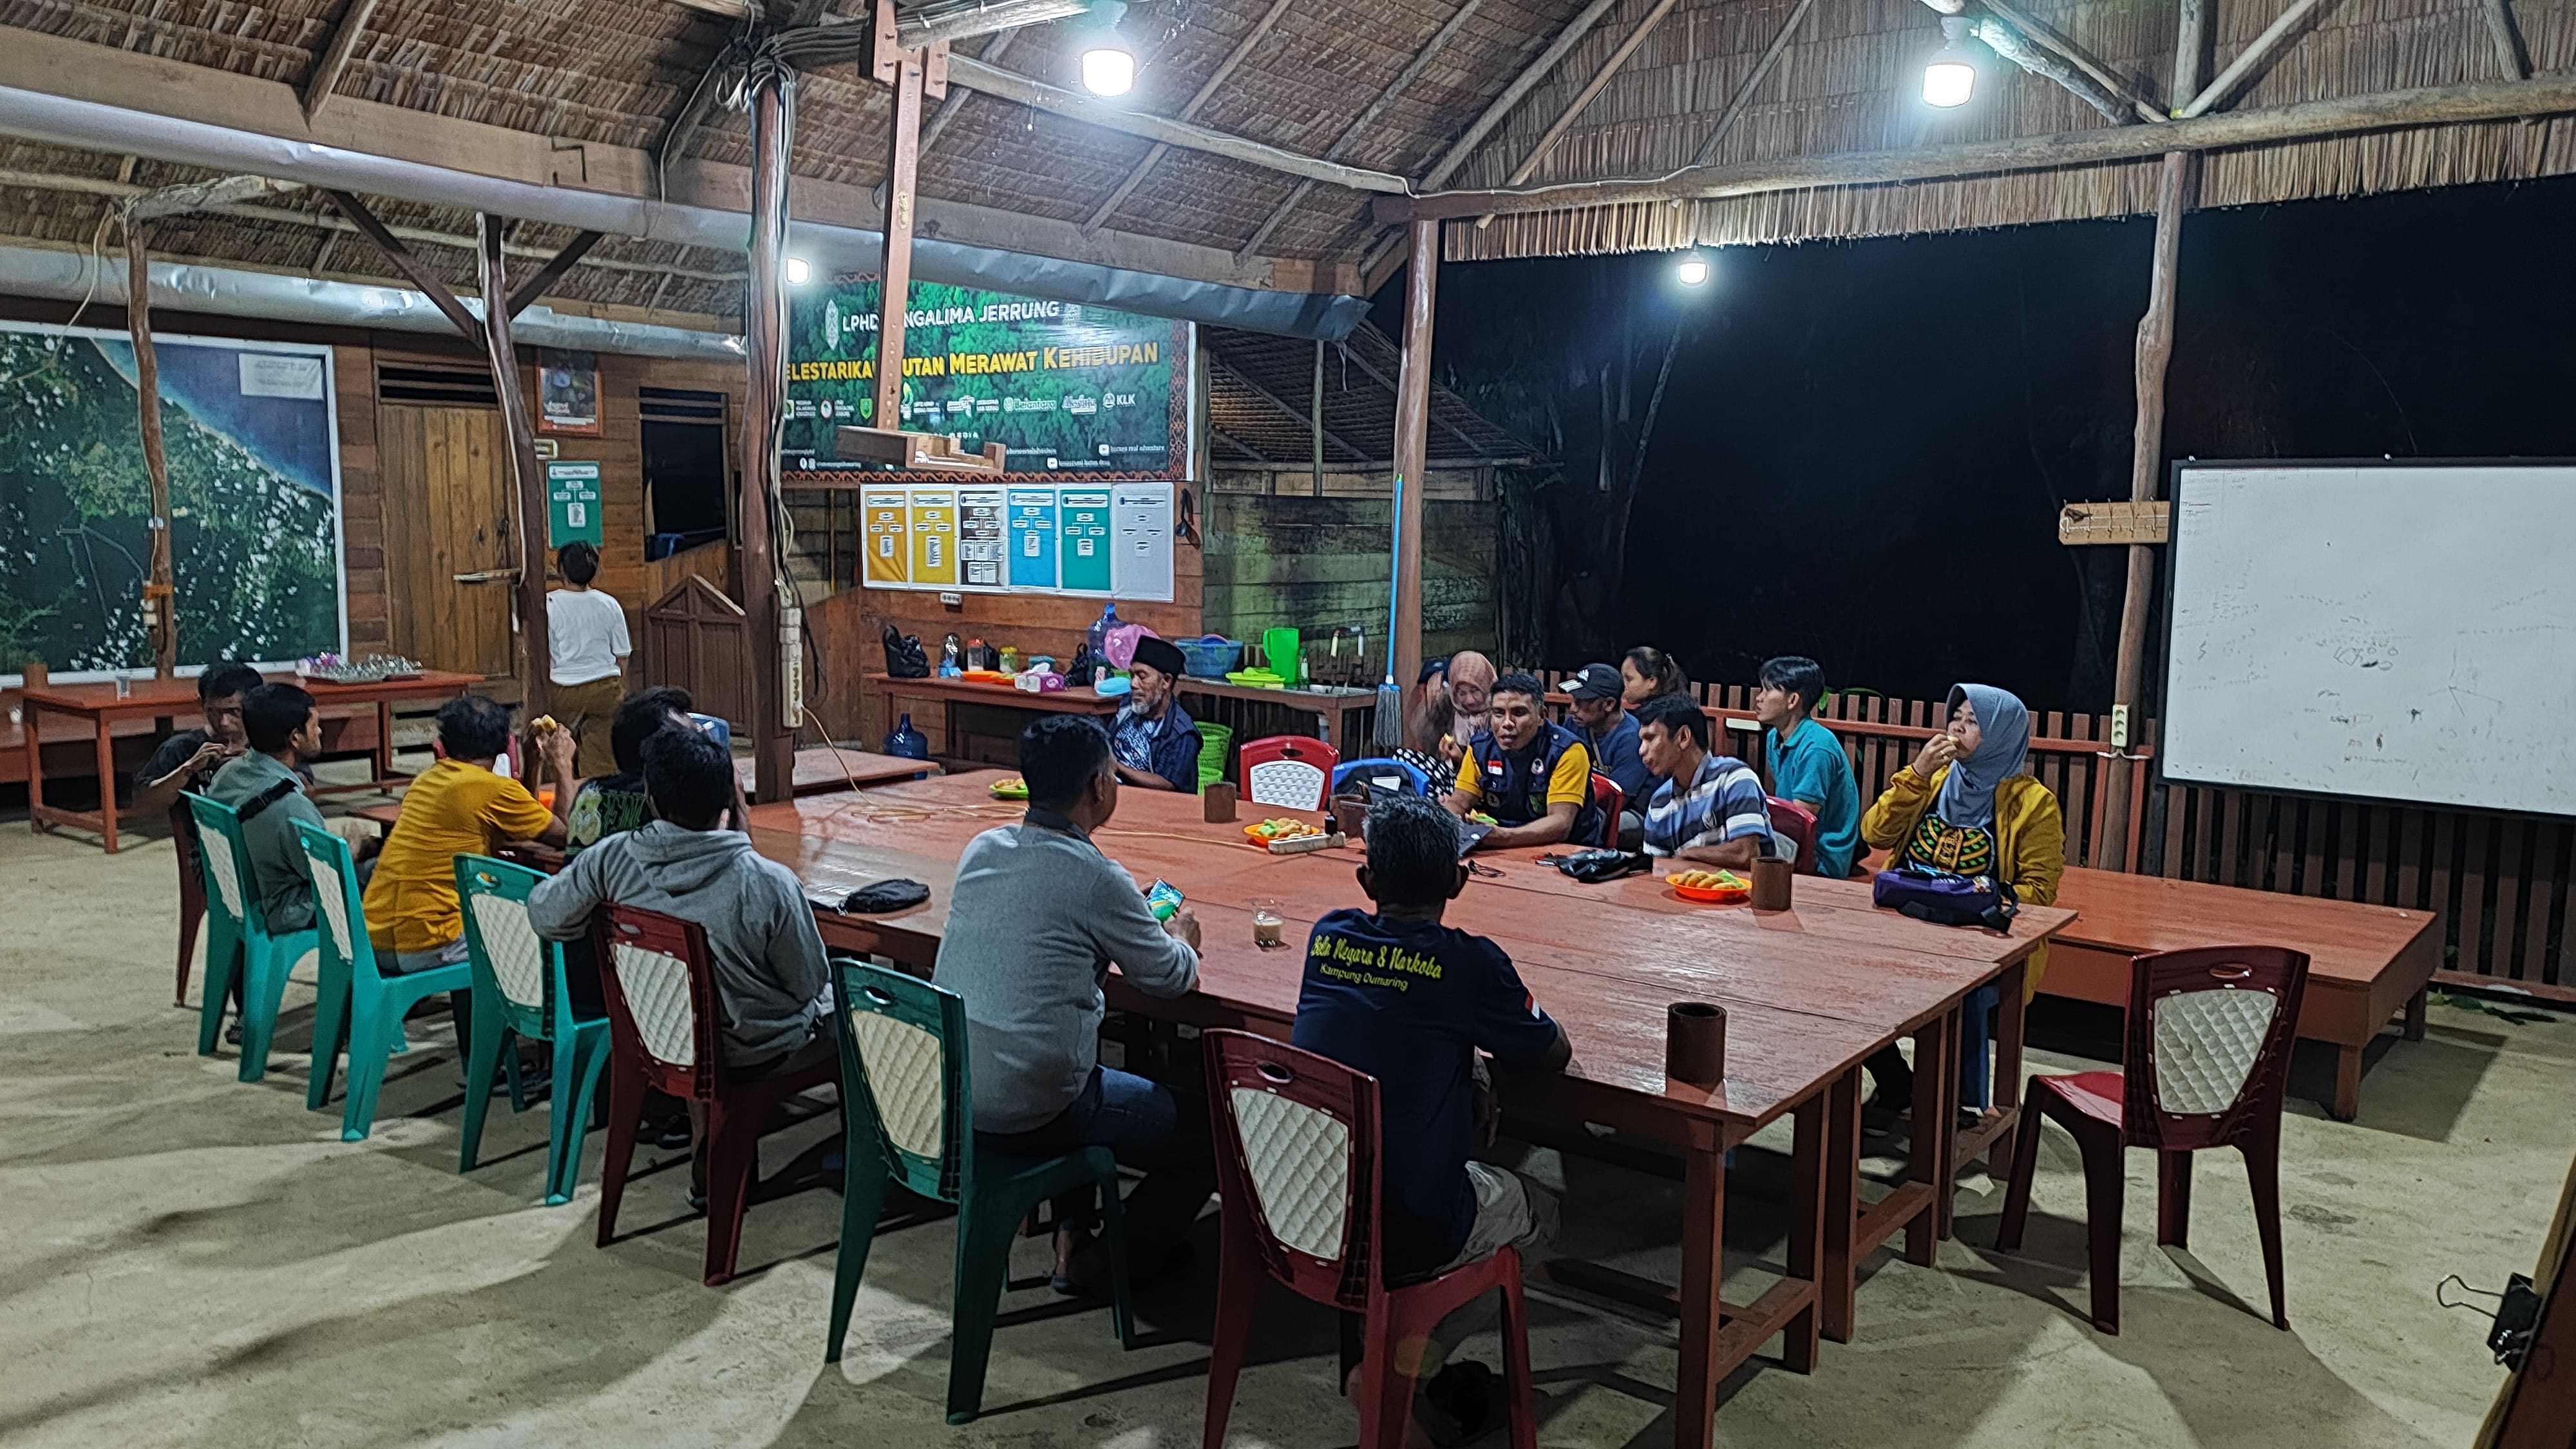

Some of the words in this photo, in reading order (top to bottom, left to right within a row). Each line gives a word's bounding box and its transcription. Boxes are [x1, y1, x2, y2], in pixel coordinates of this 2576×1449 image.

[903, 305, 976, 328] NGALIMA
[978, 300, 1060, 322] JERRUNG
[787, 360, 876, 381] ELESTARIKA
[902, 356, 945, 377] UTAN
[1116, 393, 1136, 406] KLK
[1332, 938, 1374, 967] Negara
[1376, 945, 1388, 968] &
[1389, 947, 1443, 980] Narkoba
[1320, 963, 1363, 984] Kampung
[1363, 972, 1409, 992] Dumaring
